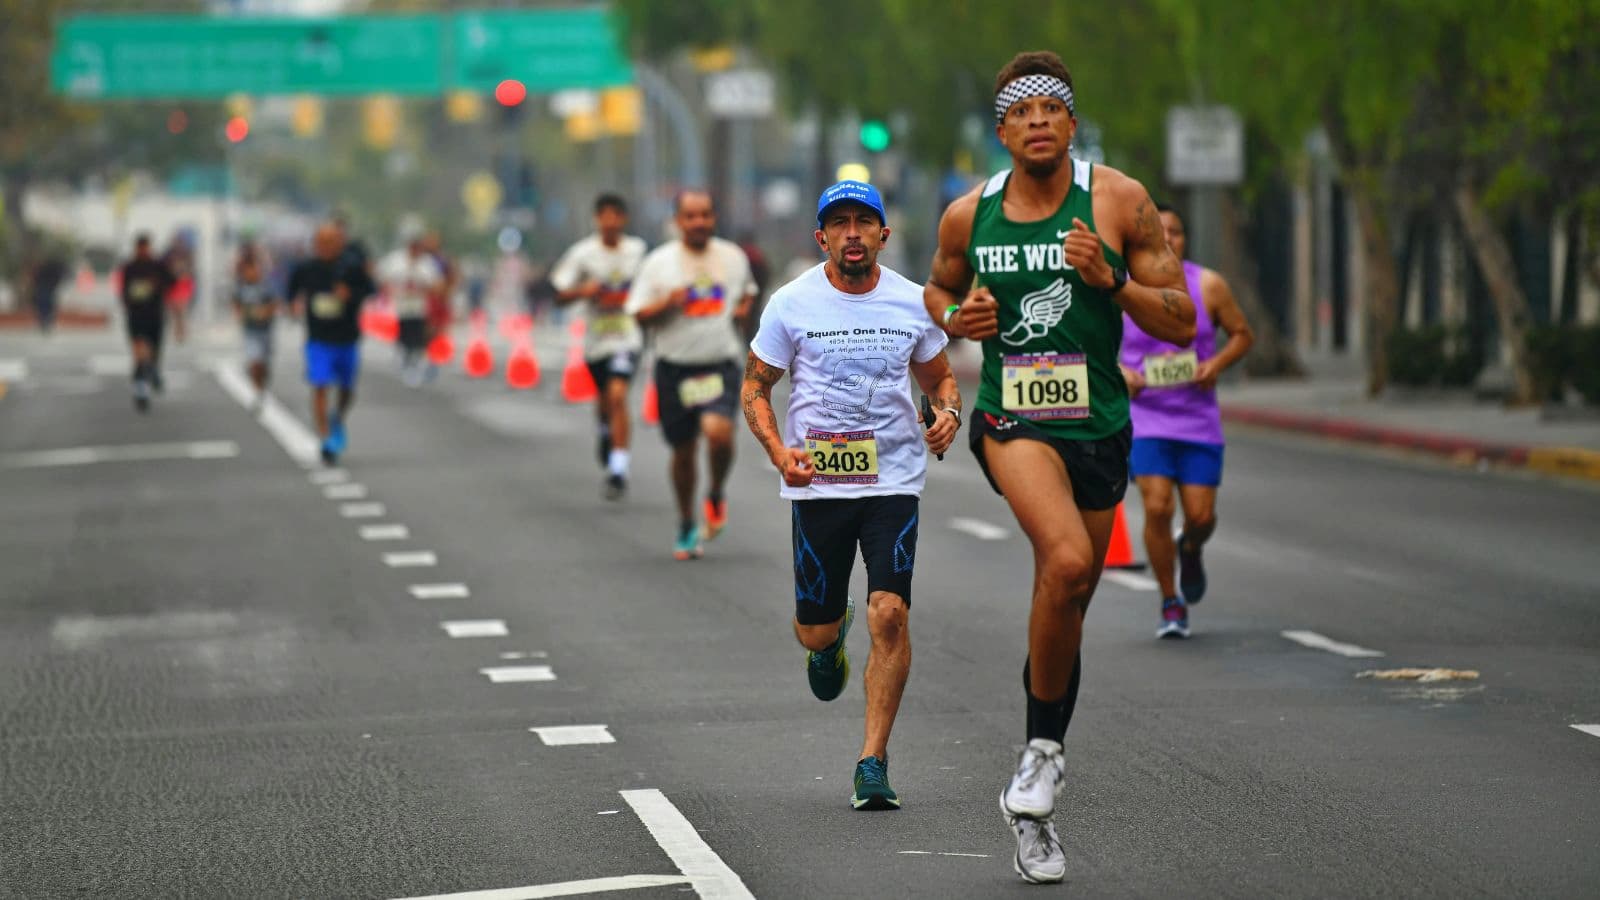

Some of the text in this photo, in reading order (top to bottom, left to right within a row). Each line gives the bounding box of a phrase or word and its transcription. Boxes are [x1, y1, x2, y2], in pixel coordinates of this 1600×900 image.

[975, 245, 1019, 273] THE
[806, 328, 913, 340] Square One Dining
[1013, 378, 1078, 406] 1098
[814, 450, 870, 472] 3403
